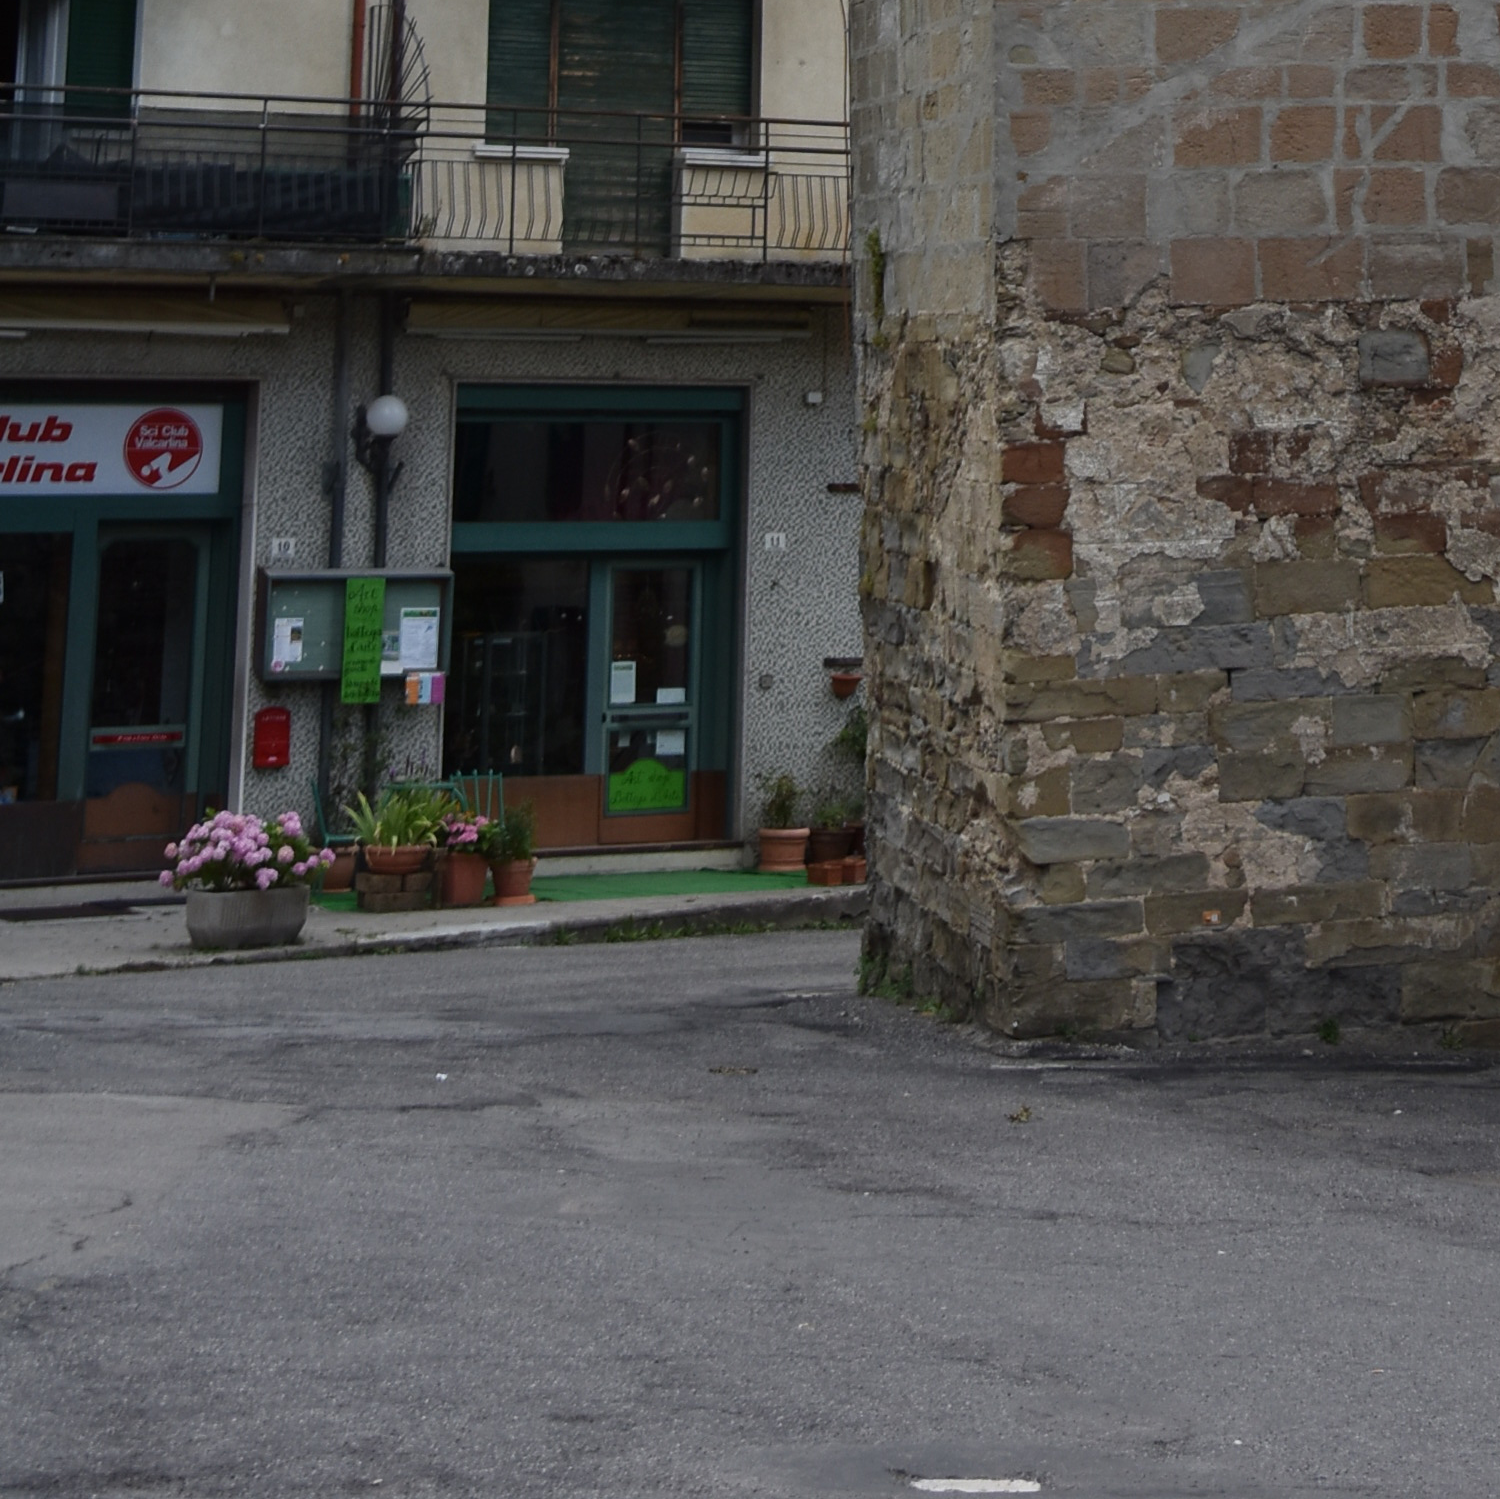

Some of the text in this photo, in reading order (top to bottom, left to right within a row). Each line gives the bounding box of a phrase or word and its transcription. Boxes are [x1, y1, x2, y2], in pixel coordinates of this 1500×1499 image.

[141, 425, 188, 436] Sci Club
[0, 455, 98, 483] lina
